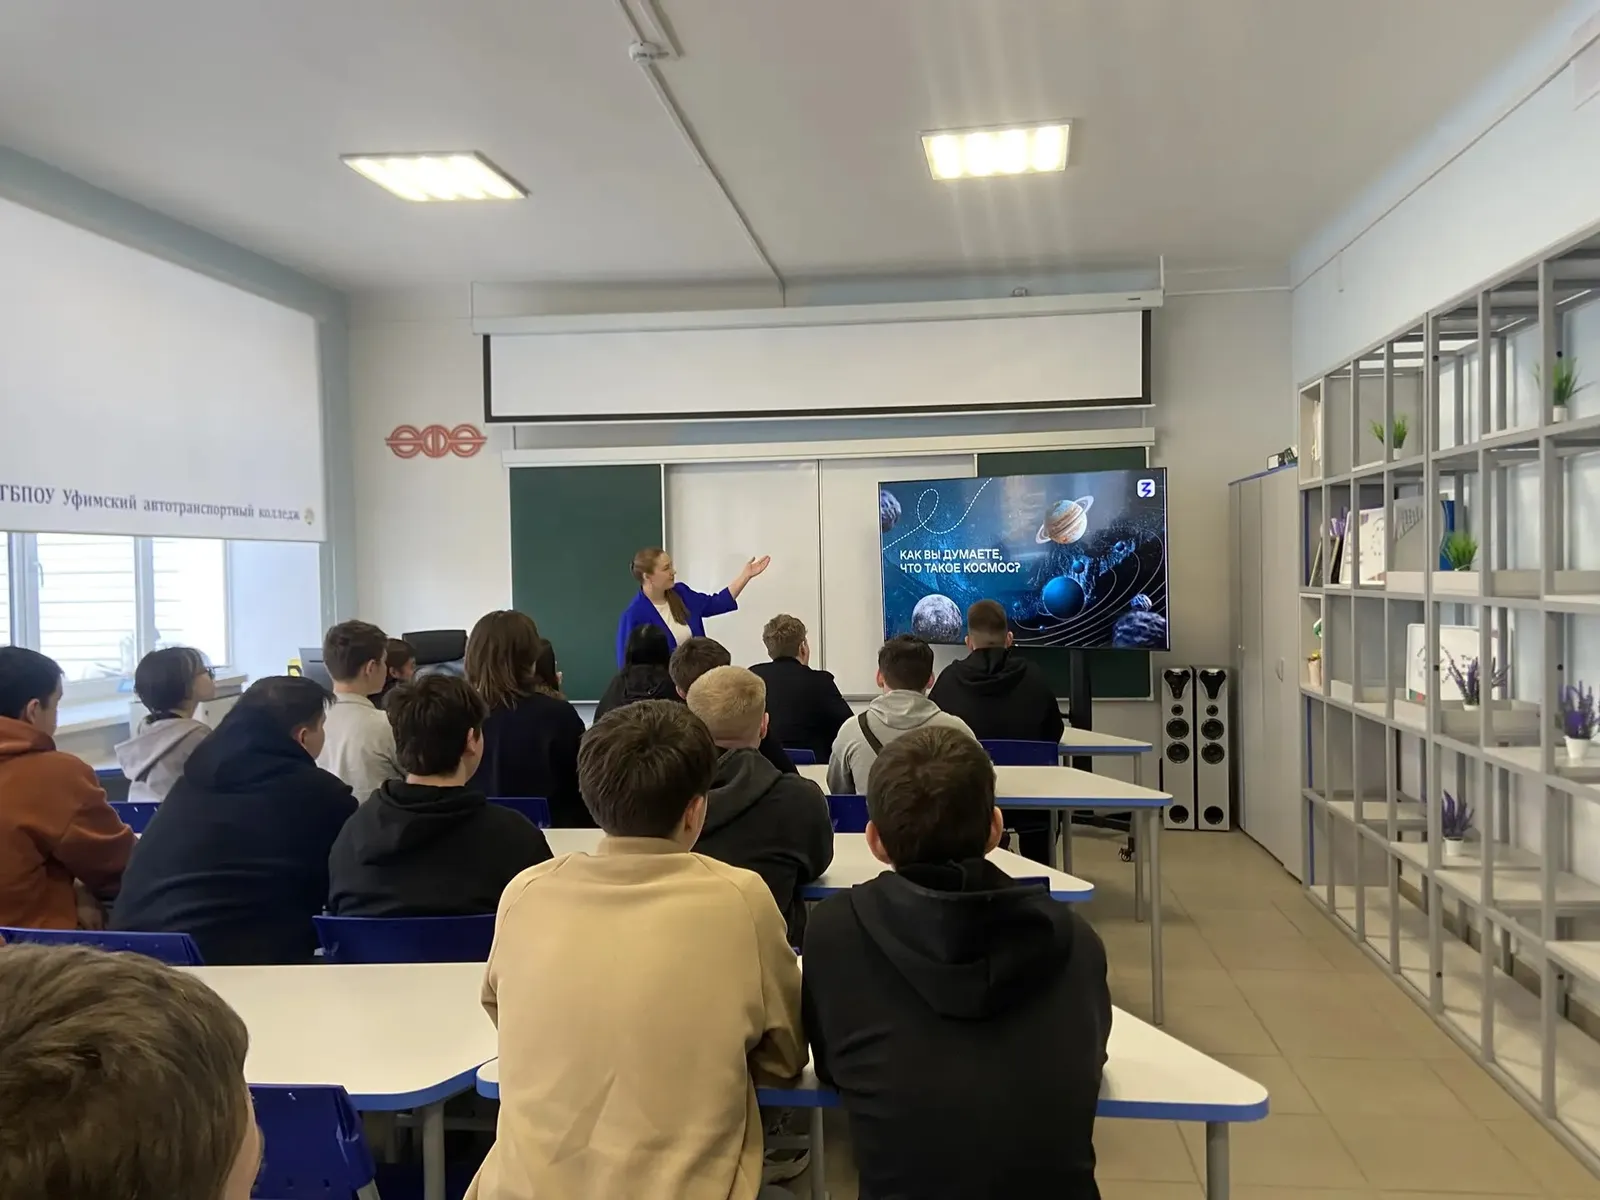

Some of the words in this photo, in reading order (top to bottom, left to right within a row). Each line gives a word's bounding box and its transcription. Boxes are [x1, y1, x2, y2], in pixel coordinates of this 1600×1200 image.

[62, 488, 137, 512] Уфимский
[143, 498, 254, 520] автотранспортный
[258, 508, 301, 521] колледж
[899, 549, 923, 561] КАК
[924, 549, 941, 560] ВЫ
[943, 548, 1003, 562] ДУМАЕТЕ,
[899, 563, 922, 574] ЧТО
[924, 563, 961, 574] ТАКОЕ
[963, 562, 1022, 574] КОСМОС?
